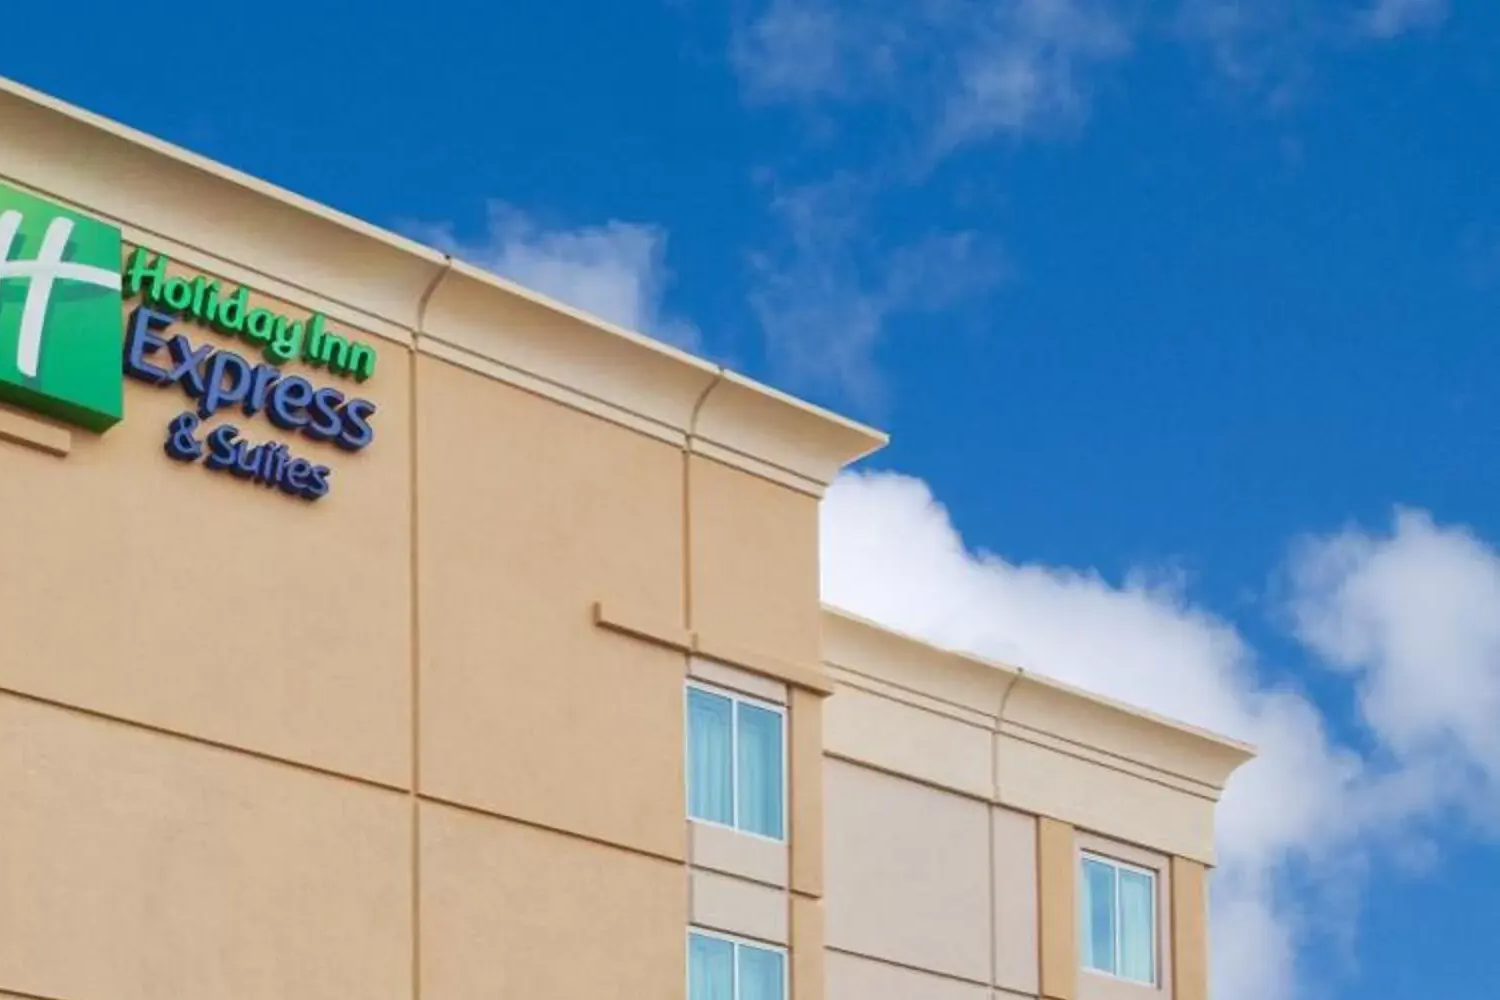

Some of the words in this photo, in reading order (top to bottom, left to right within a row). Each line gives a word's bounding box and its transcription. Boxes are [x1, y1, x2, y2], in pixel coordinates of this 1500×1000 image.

[124, 306, 377, 450] Express
[125, 246, 301, 363] Holiday
[301, 311, 377, 382] Inn
[165, 412, 206, 462] &
[207, 424, 330, 500] Suites
